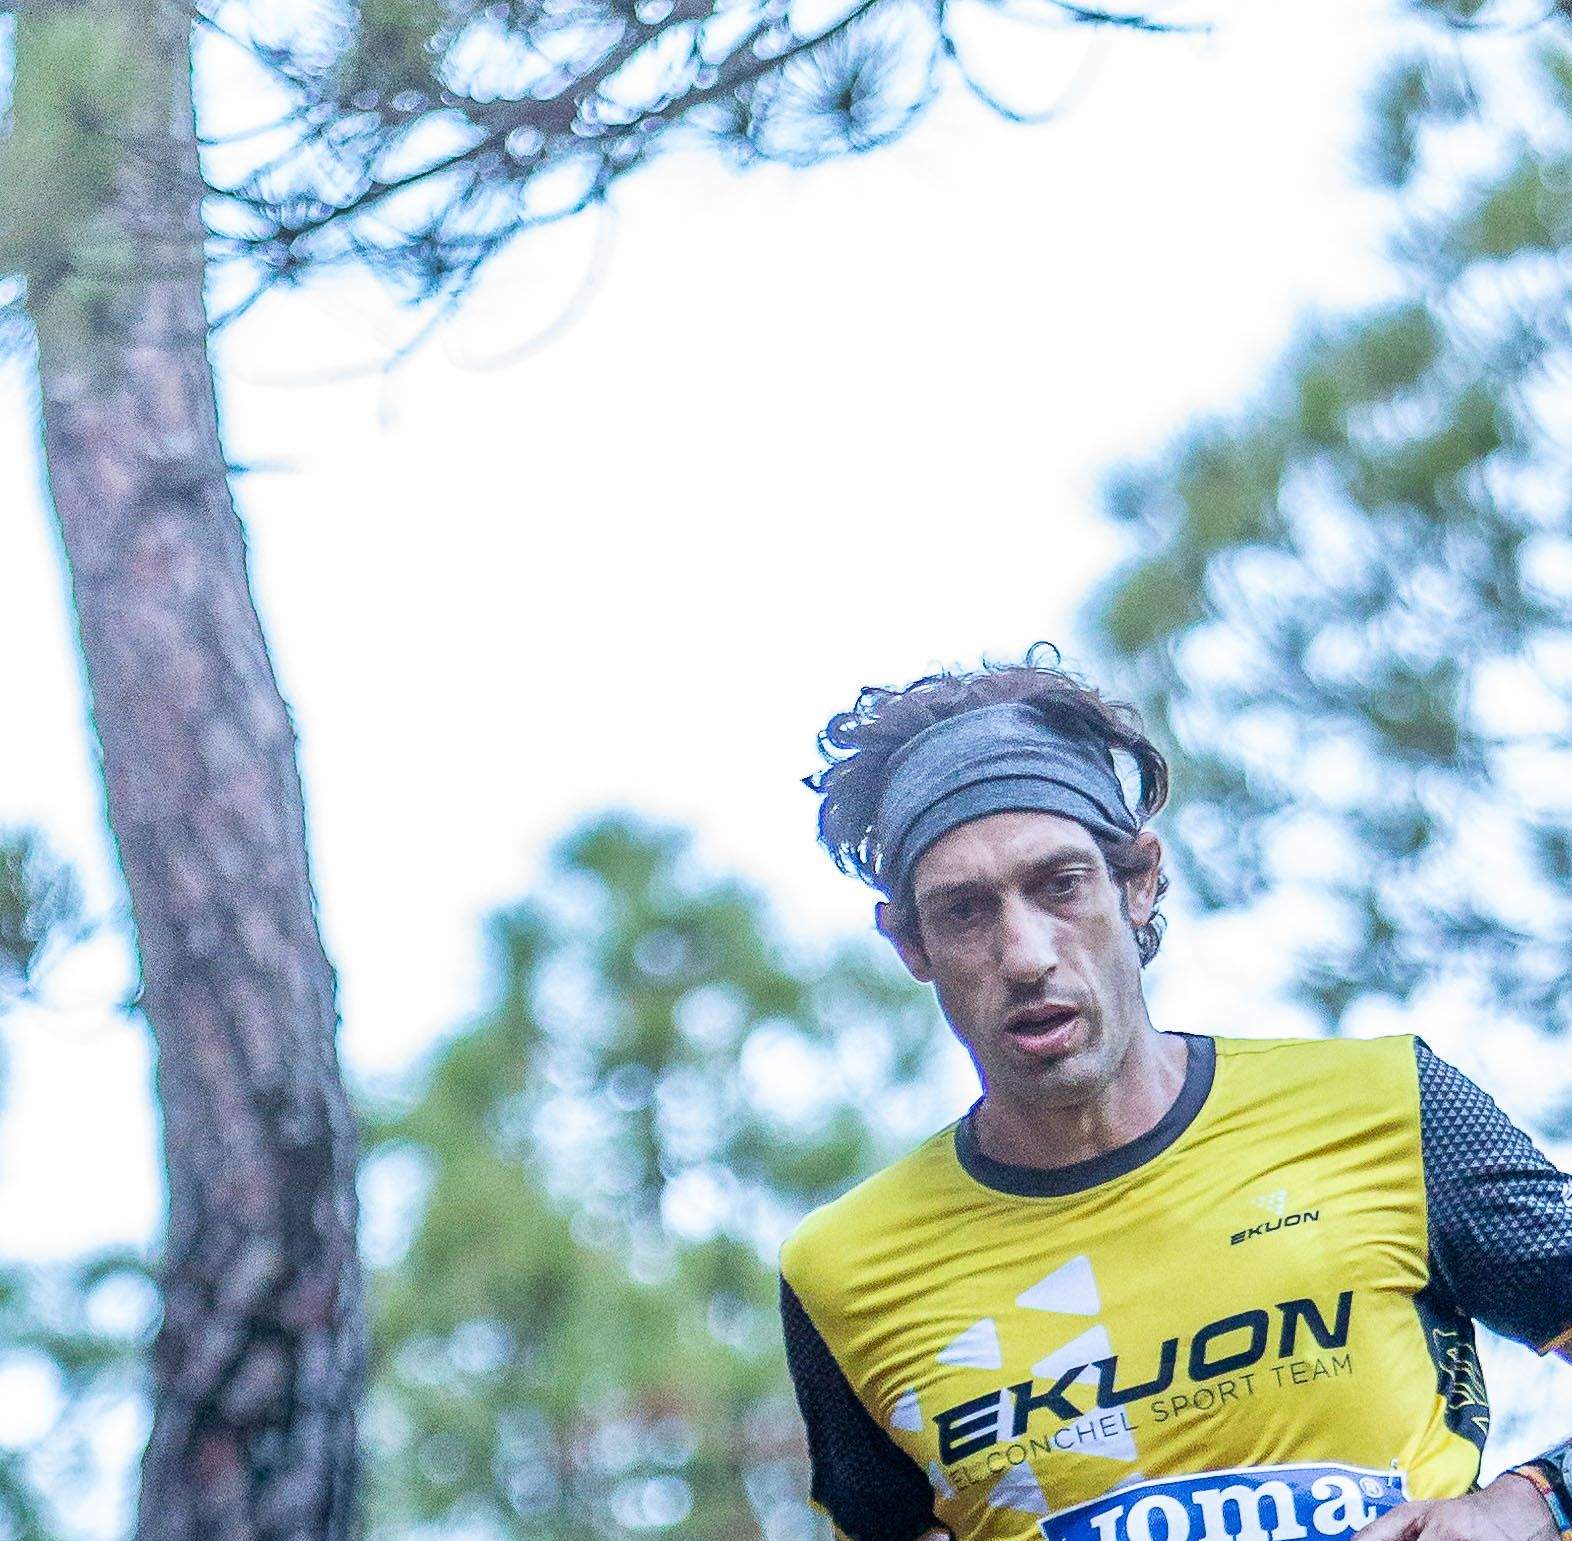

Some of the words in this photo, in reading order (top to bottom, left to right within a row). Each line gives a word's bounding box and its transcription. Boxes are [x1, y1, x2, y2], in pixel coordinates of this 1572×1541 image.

[1230, 1210, 1320, 1246] EKUON
[932, 1290, 1354, 1466] EKUON
[987, 1410, 1139, 1473] CONCHEL
[1151, 1373, 1255, 1422] SPORT
[1271, 1353, 1353, 1388] TEAM
